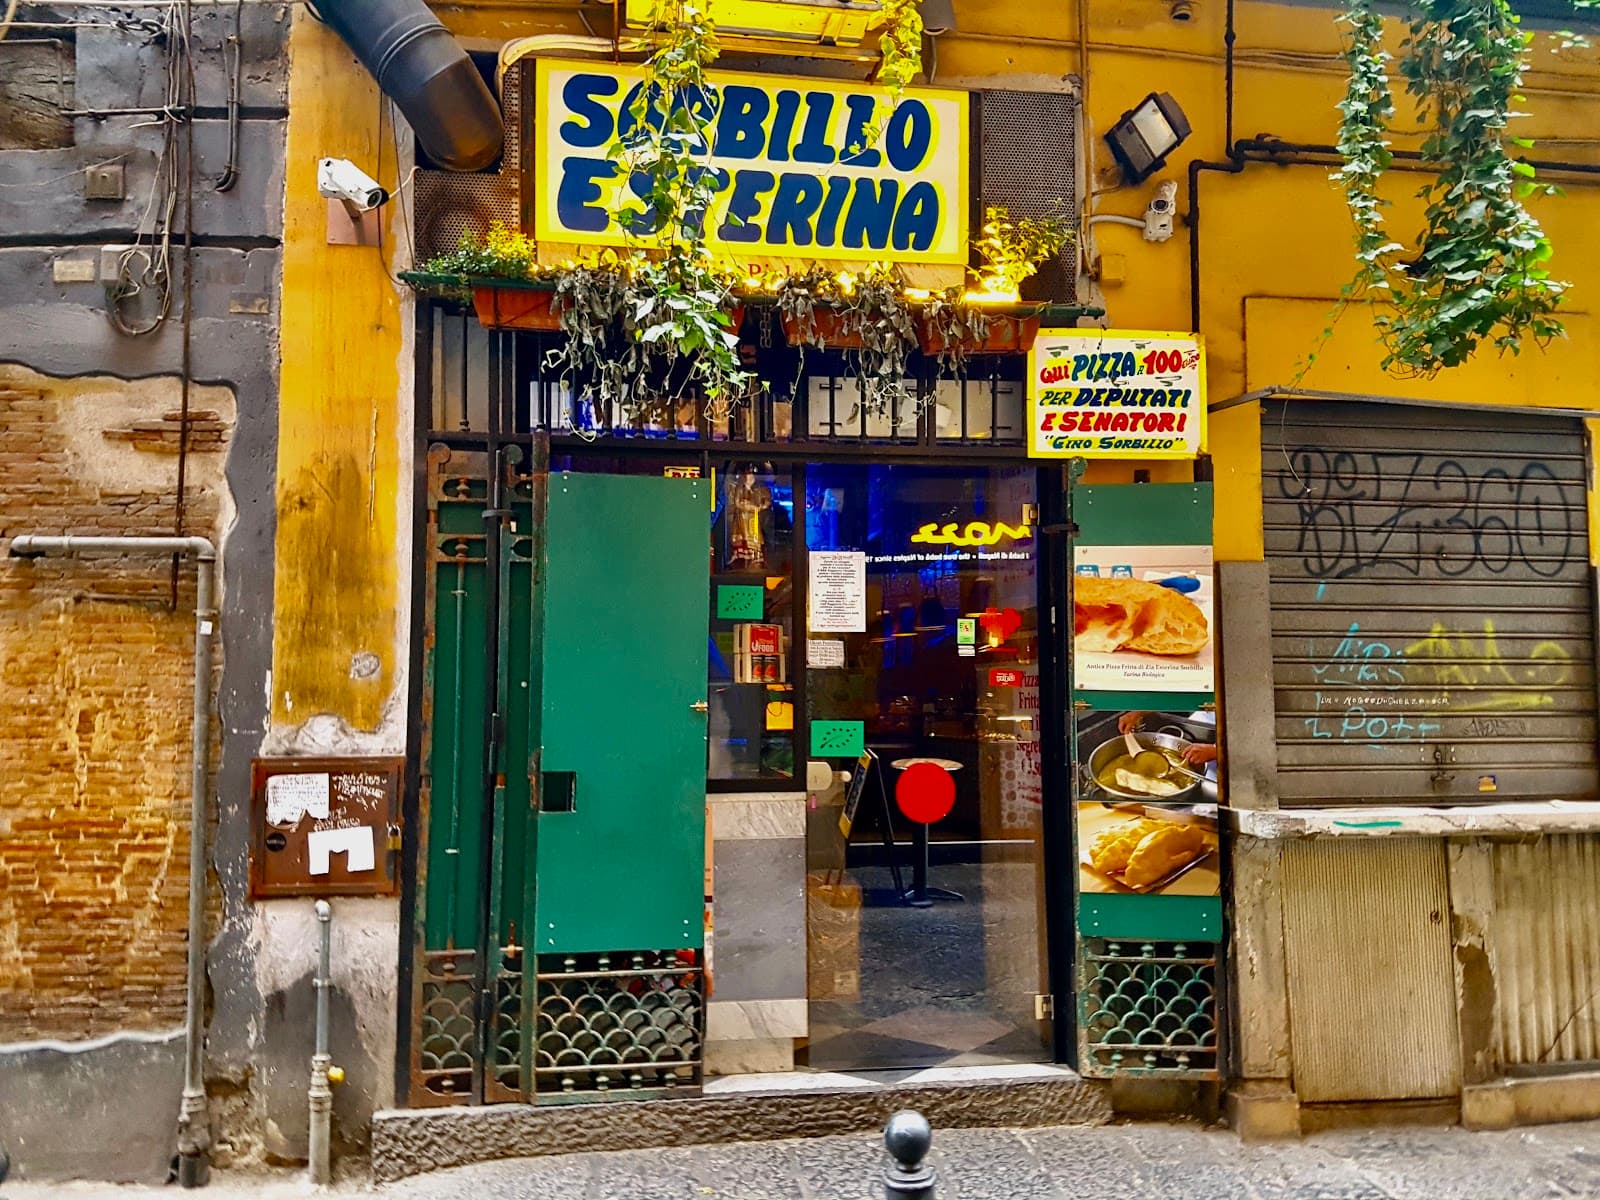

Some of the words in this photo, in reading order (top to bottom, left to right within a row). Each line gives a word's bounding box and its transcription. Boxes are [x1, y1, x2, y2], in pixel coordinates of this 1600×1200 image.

[560, 74, 932, 172] SORBILLO
[558, 157, 939, 251] ESTERINA
[1071, 352, 1136, 381] PIZZA
[1143, 350, 1182, 375] 100
[1039, 391, 1072, 407] PER
[1073, 388, 1192, 408] DEPUTATI
[1040, 413, 1057, 431] E
[1059, 411, 1187, 432] SENATORI
